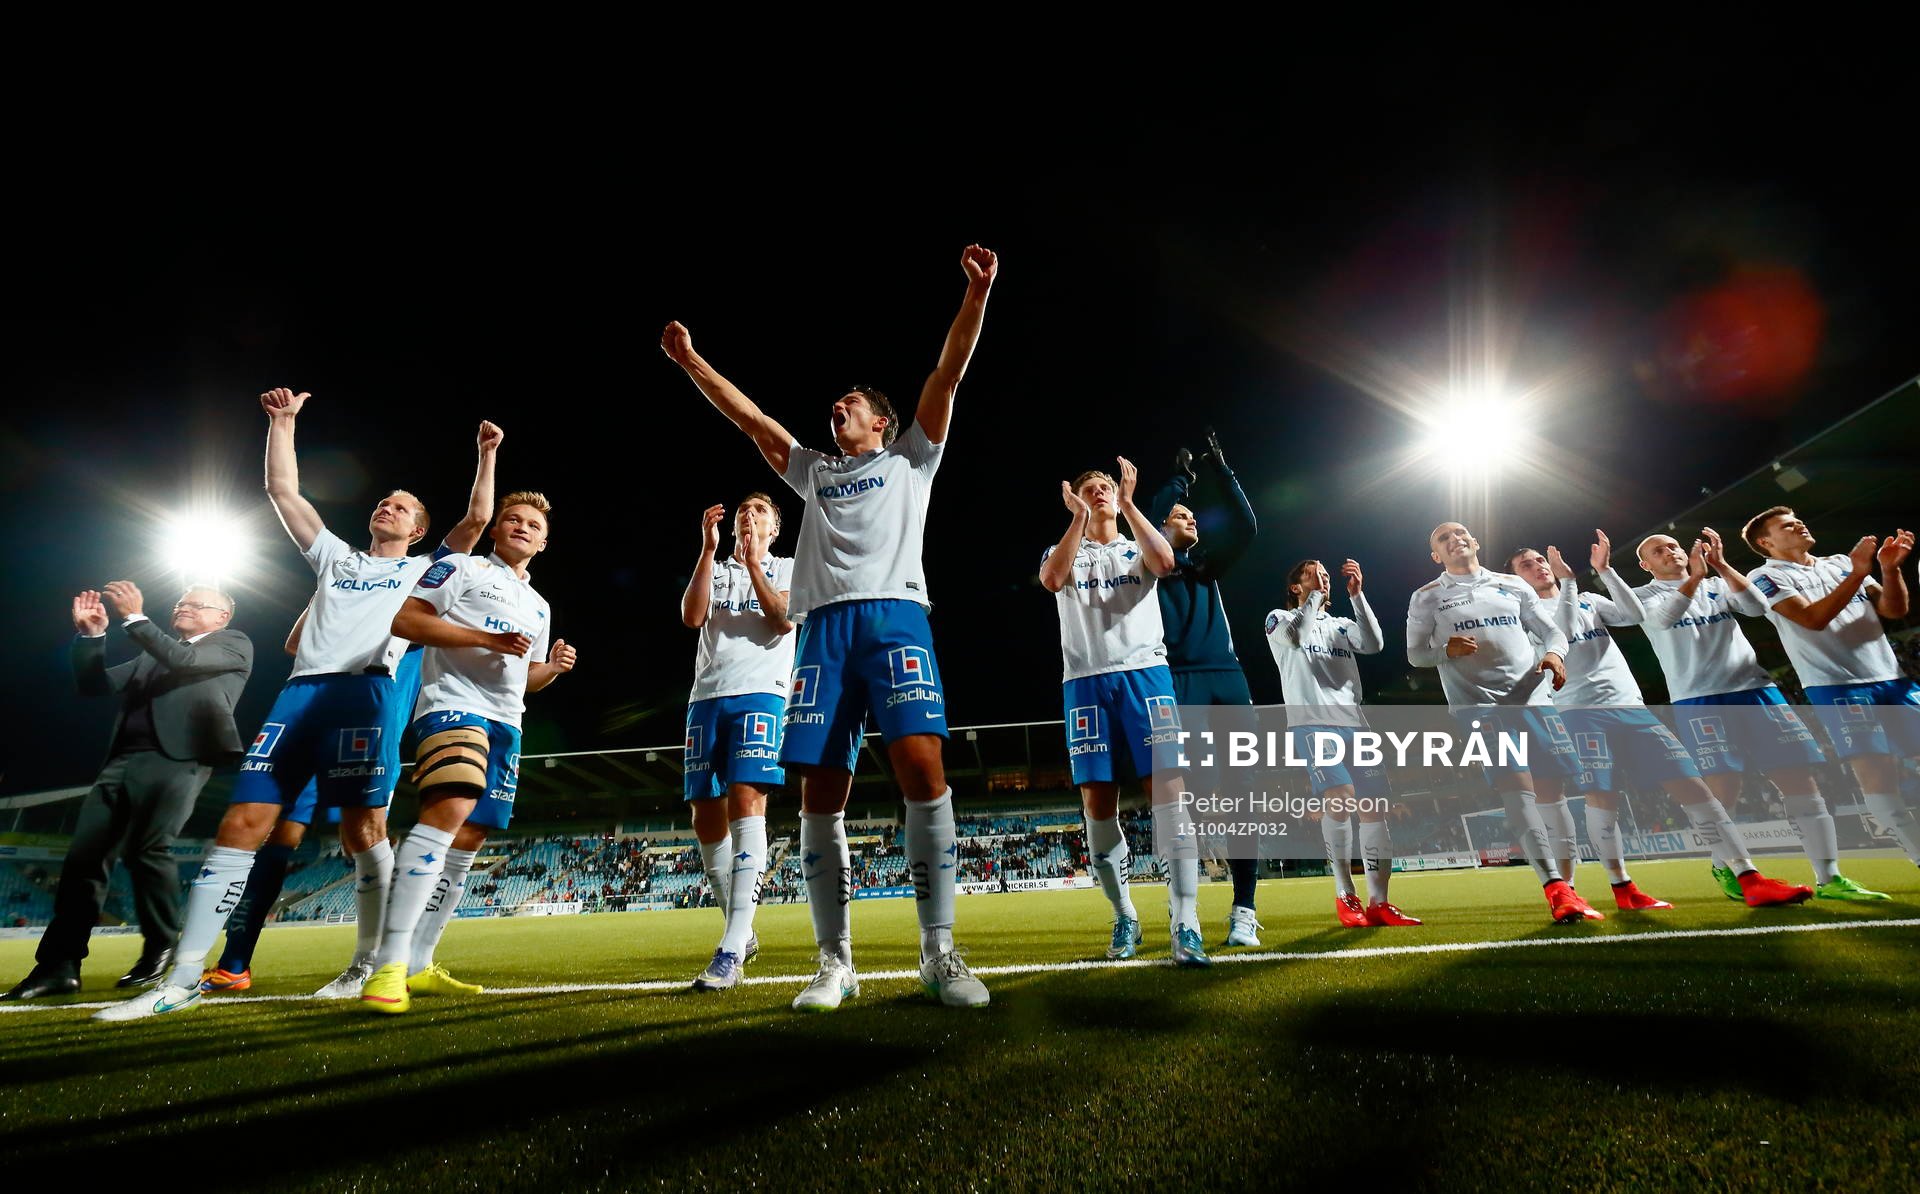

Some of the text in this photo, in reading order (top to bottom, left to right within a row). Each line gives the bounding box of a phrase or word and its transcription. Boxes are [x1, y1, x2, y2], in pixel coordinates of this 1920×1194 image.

[714, 599, 762, 612] HOLME
[1453, 616, 1518, 631] HOLMEN
[1567, 629, 1608, 644] LMEN
[1304, 644, 1352, 659] HOLMEN
[887, 687, 942, 709] stadium
[1143, 731, 1179, 746] stadiu
[735, 748, 778, 760] stadium
[1698, 755, 1716, 770] 20
[328, 765, 385, 778] stadium
[489, 789, 515, 802] stad
[1622, 832, 1687, 855] LMEN
[1365, 846, 1380, 872] SITA
[1119, 855, 1130, 885] SITA
[911, 862, 930, 900] SITA
[961, 880, 1049, 892] WWW.ABYNICKERI.SE
[215, 881, 246, 916] SITA
